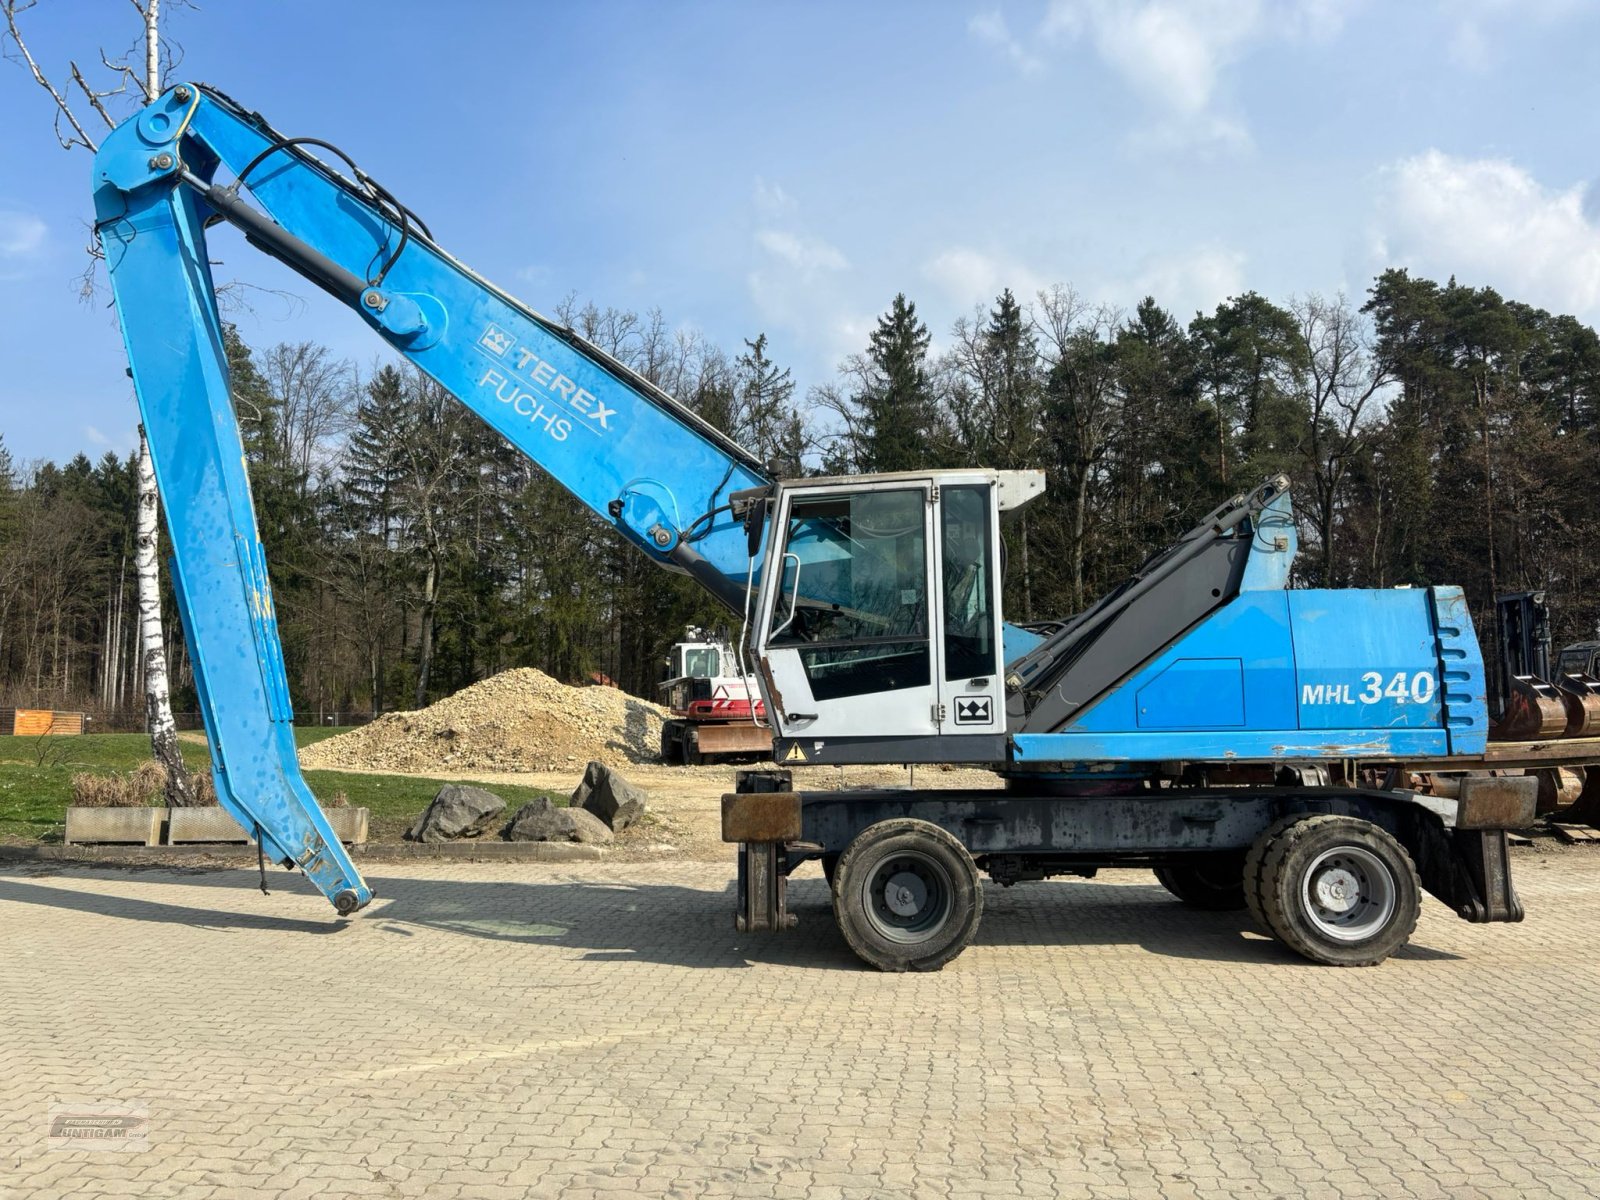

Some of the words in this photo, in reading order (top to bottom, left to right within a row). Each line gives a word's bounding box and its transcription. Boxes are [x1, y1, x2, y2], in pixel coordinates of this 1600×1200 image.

[479, 369, 572, 441] FUCHS
[517, 347, 617, 429] TEREX
[1302, 685, 1356, 705] MHL
[1359, 671, 1435, 704] 340
